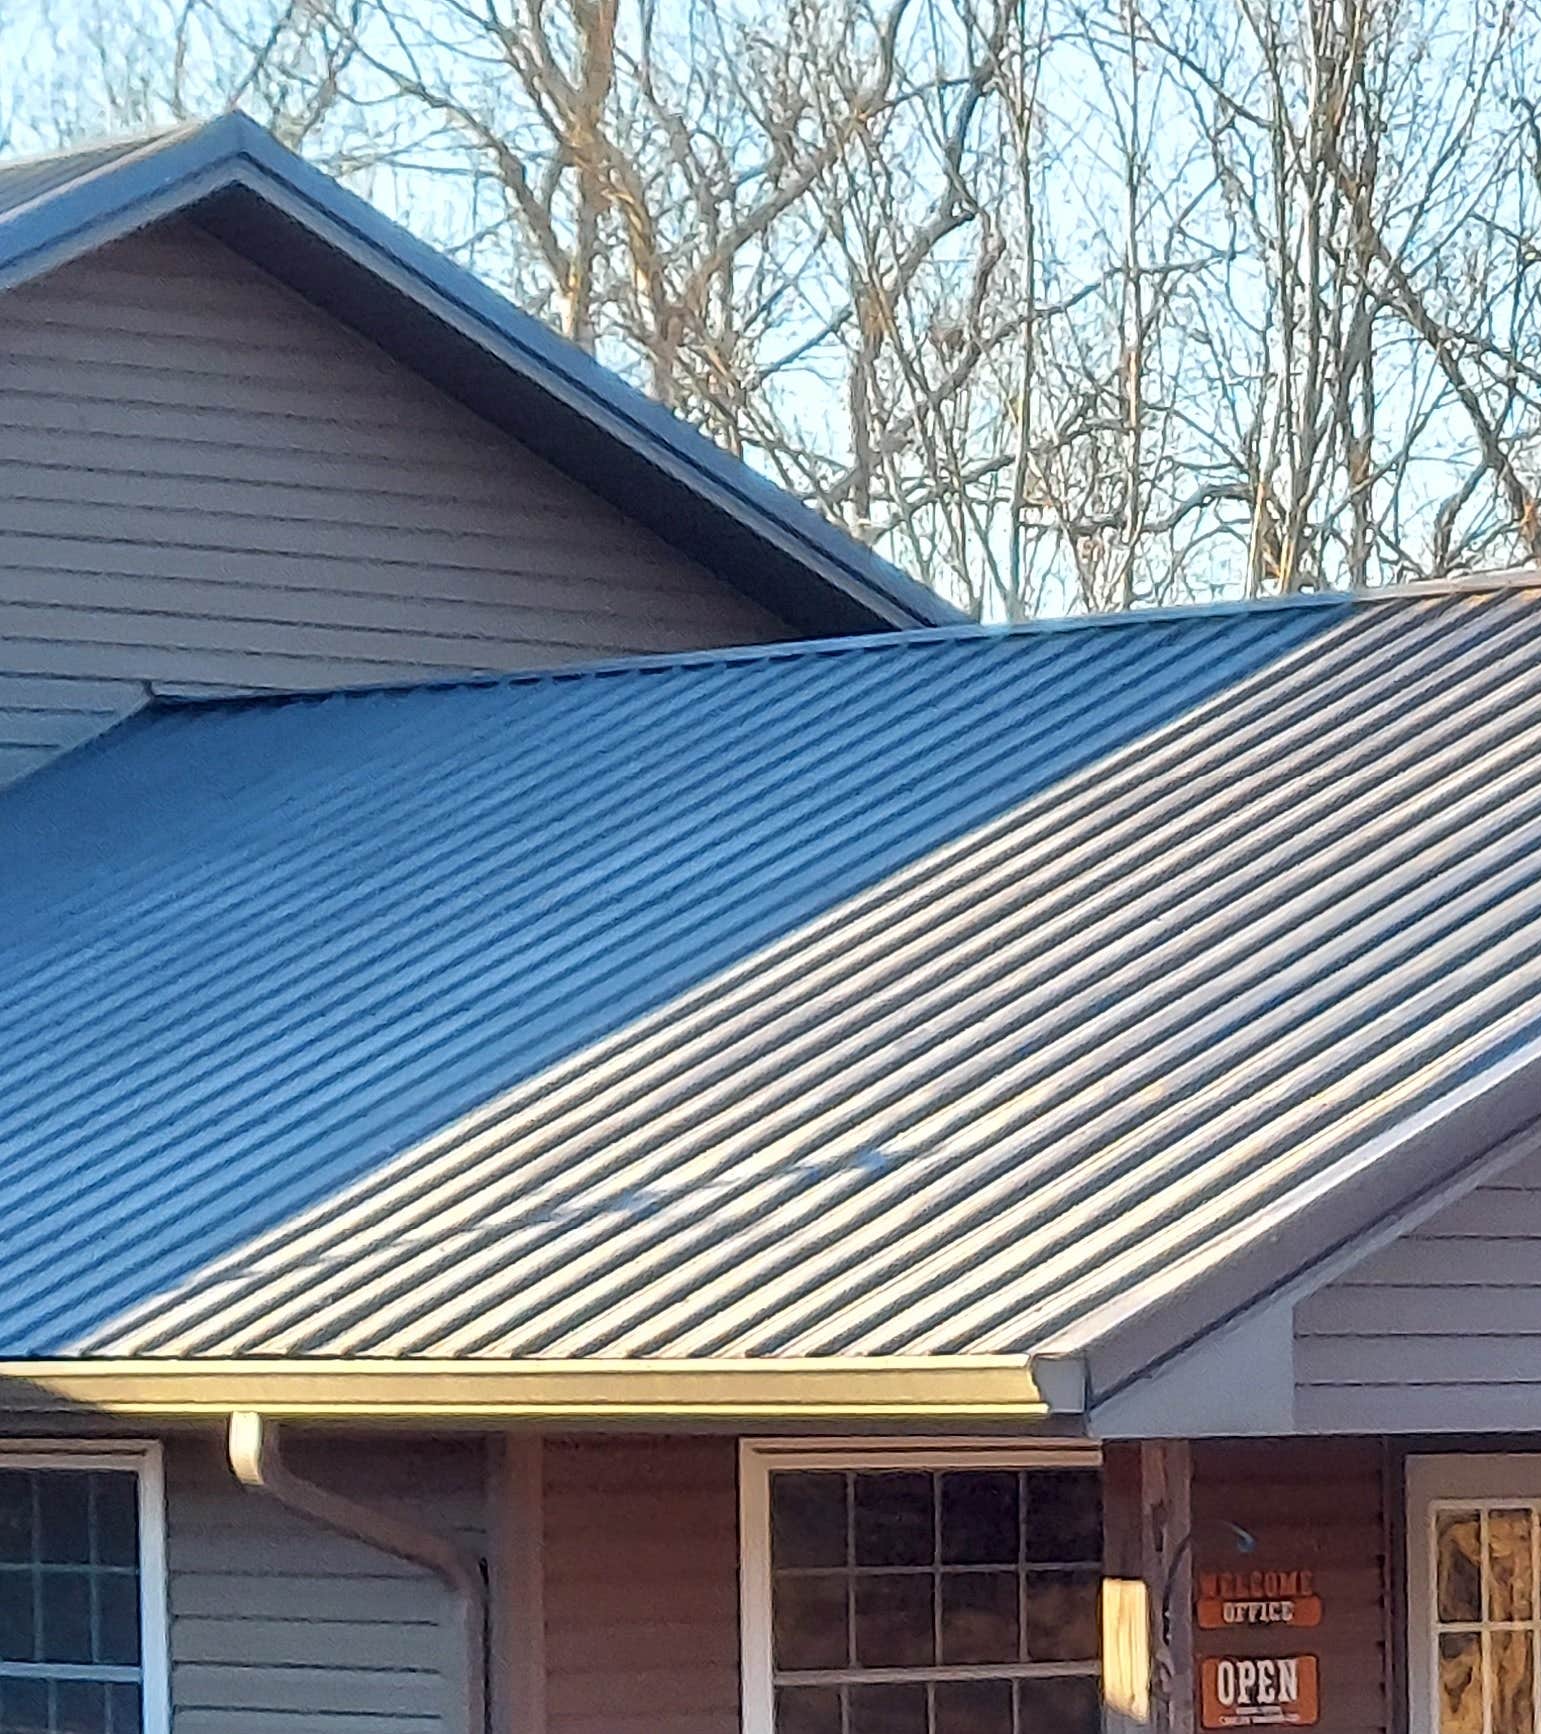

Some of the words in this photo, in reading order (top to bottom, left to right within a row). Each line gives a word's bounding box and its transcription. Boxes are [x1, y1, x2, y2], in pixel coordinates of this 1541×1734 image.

[1202, 1570, 1312, 1597] WELCOME
[1222, 1600, 1294, 1623] OFFICE
[1217, 1659, 1297, 1706] OPEN
